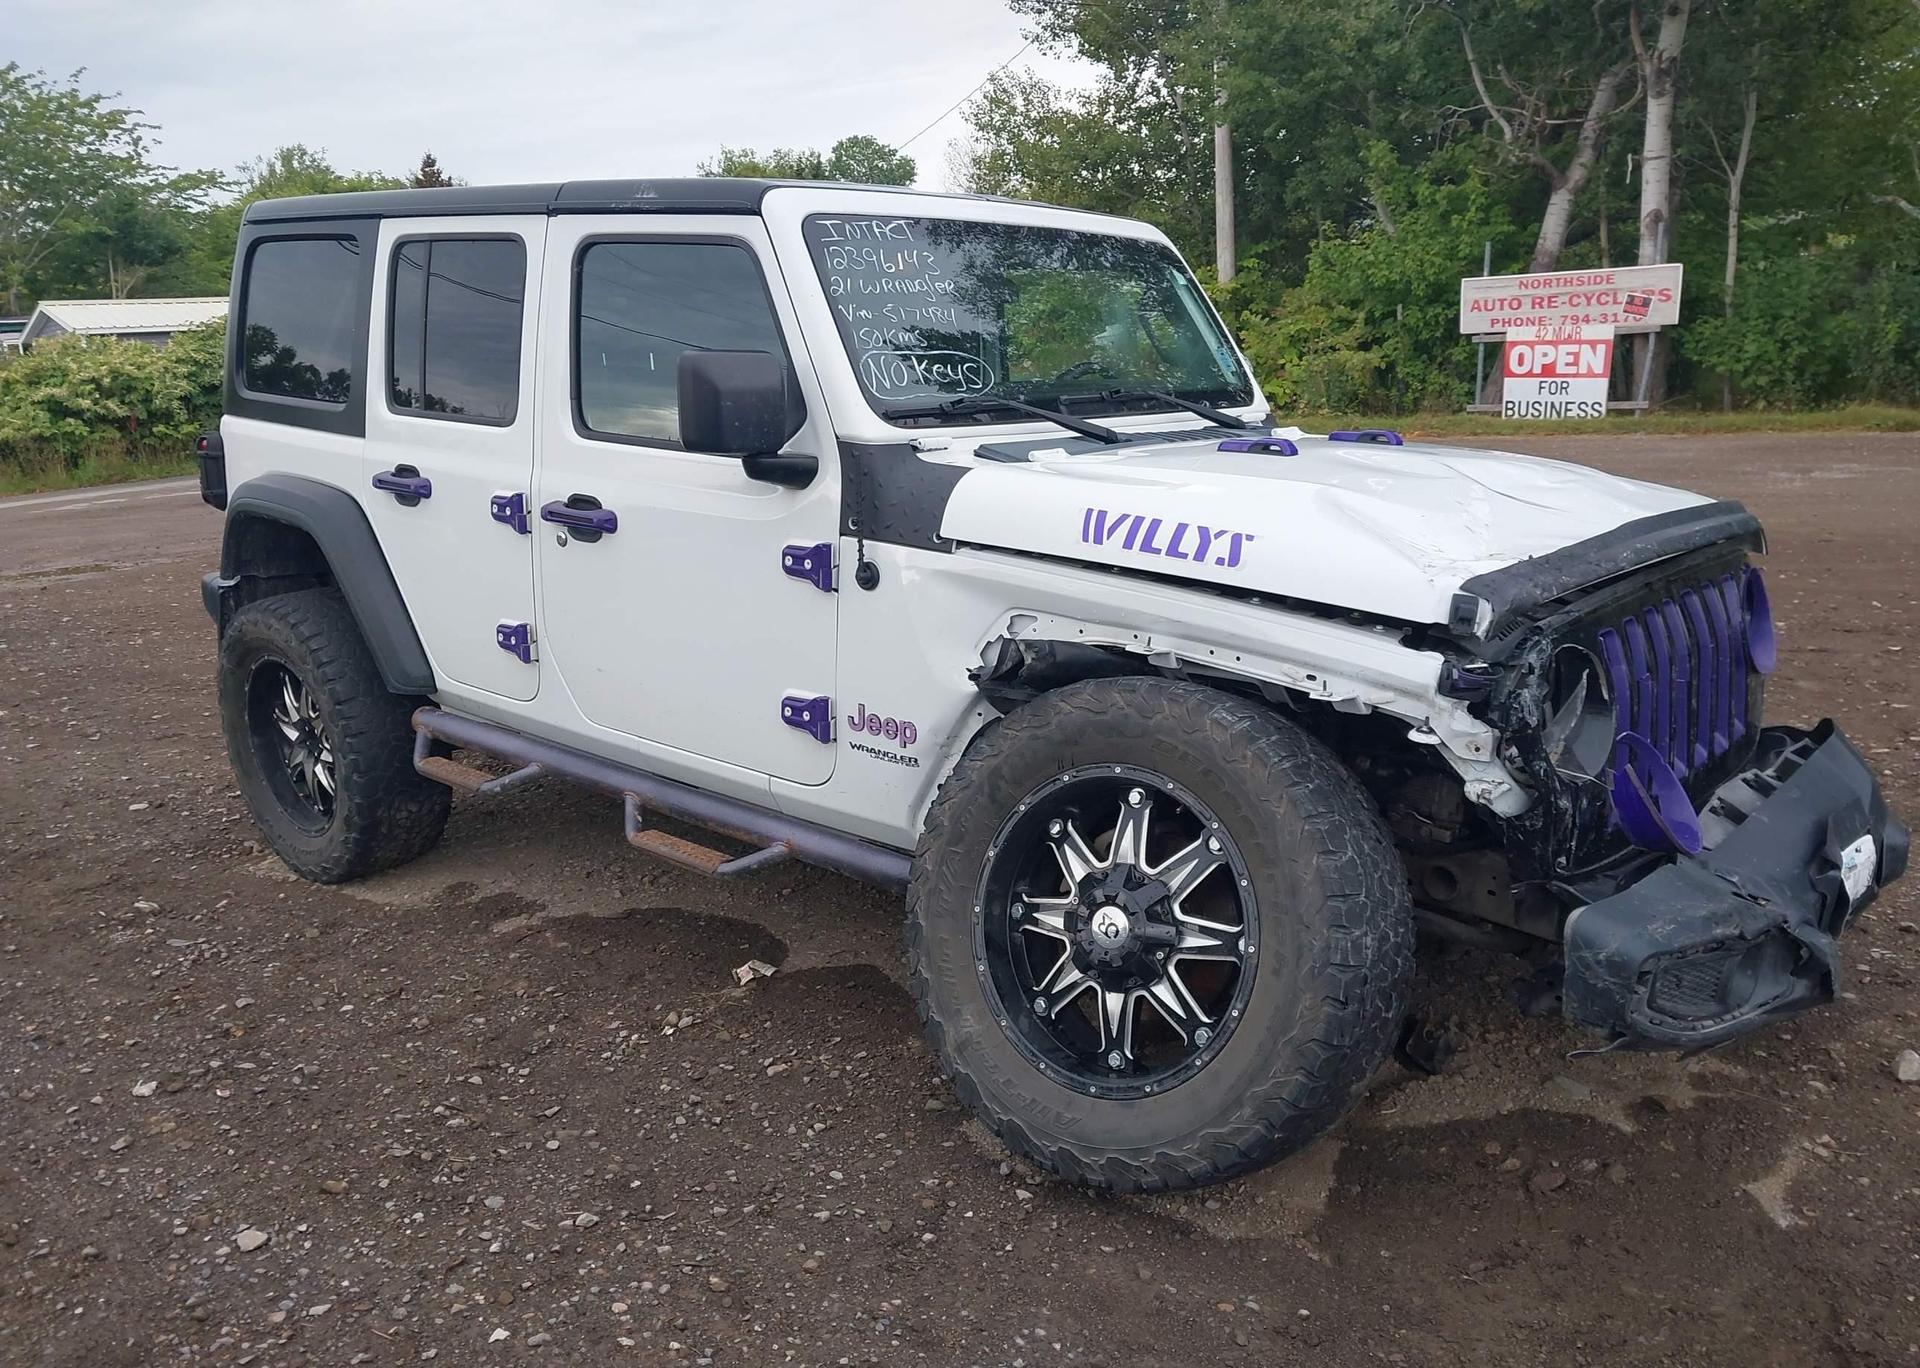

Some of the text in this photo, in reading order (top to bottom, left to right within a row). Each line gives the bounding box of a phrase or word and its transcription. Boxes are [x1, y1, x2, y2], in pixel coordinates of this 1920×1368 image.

[816, 220, 914, 242] INTACT
[824, 246, 940, 275] 12396143
[830, 276, 850, 296] 21
[1518, 274, 1615, 290] NORTHSIDE
[1470, 297, 1523, 313] AUTO
[1531, 287, 1673, 310] RE-CYCLS
[1490, 316, 1553, 329] PHONE:
[1509, 344, 1606, 375] OPEN
[867, 355, 908, 392] NO
[1538, 380, 1570, 396] FOR
[1504, 400, 1603, 419] BUSINESS
[1082, 507, 1255, 568] WILLYS
[847, 702, 918, 749] Jeep
[848, 741, 919, 764] WRANGLER
